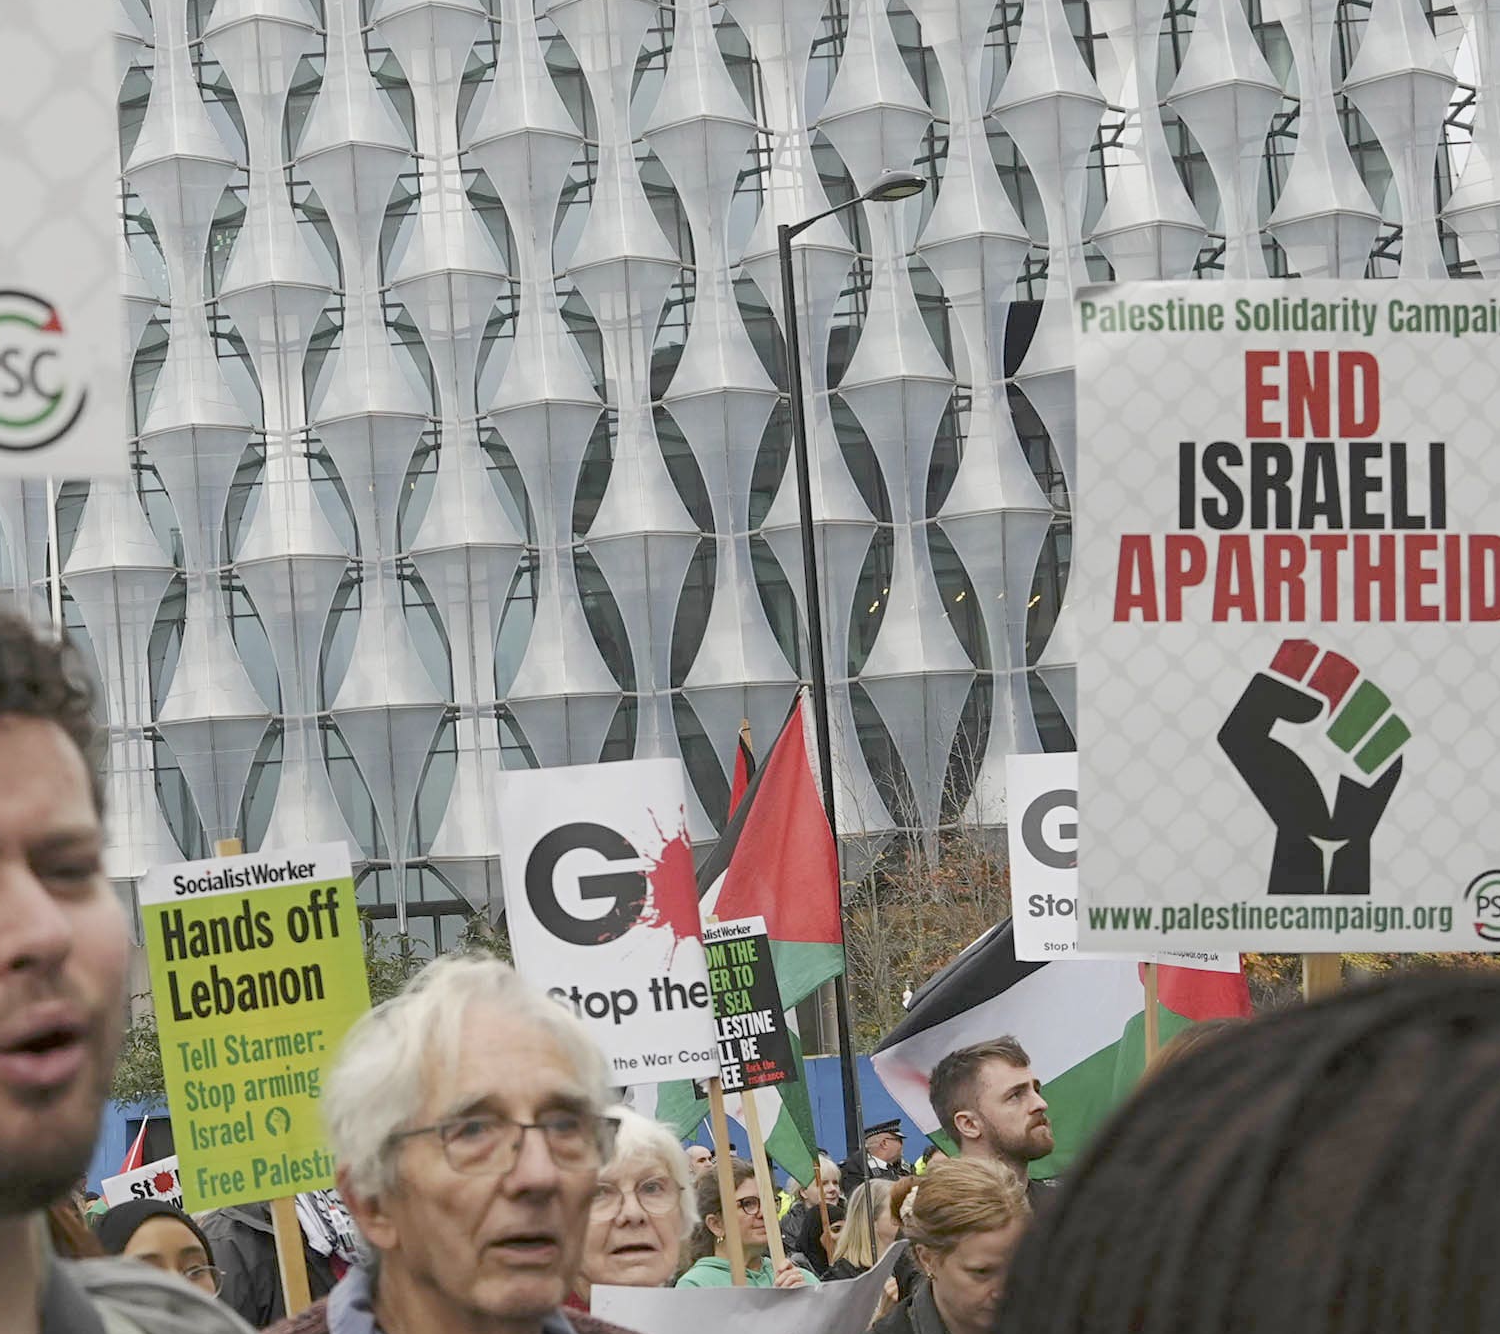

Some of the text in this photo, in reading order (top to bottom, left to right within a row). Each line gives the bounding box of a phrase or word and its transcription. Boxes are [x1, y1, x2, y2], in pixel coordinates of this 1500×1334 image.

[1080, 299, 1224, 333] Palestine
[1234, 298, 1377, 336] Solidarity
[1244, 350, 1379, 438] END
[1179, 442, 1445, 530] ISRAELI
[174, 861, 316, 896] Socialist Worker
[1028, 893, 1077, 920] Sto
[1088, 901, 1453, 934] www.palestinecampaign.org
[160, 887, 340, 961] Hands off
[722, 924, 751, 936] Worker
[729, 940, 758, 964] THE
[1044, 942, 1069, 952] Stop
[168, 963, 325, 1022] Lebanon
[734, 965, 754, 988] TO
[649, 977, 708, 1012] the
[724, 992, 752, 1015] SEA
[178, 1029, 325, 1073] Tell Starmer:
[614, 1056, 637, 1070] the
[643, 1054, 673, 1067] War
[740, 1037, 760, 1062] BE
[184, 1065, 321, 1113] Stop arming
[190, 1113, 254, 1150] Israel
[196, 1165, 245, 1199] Free
